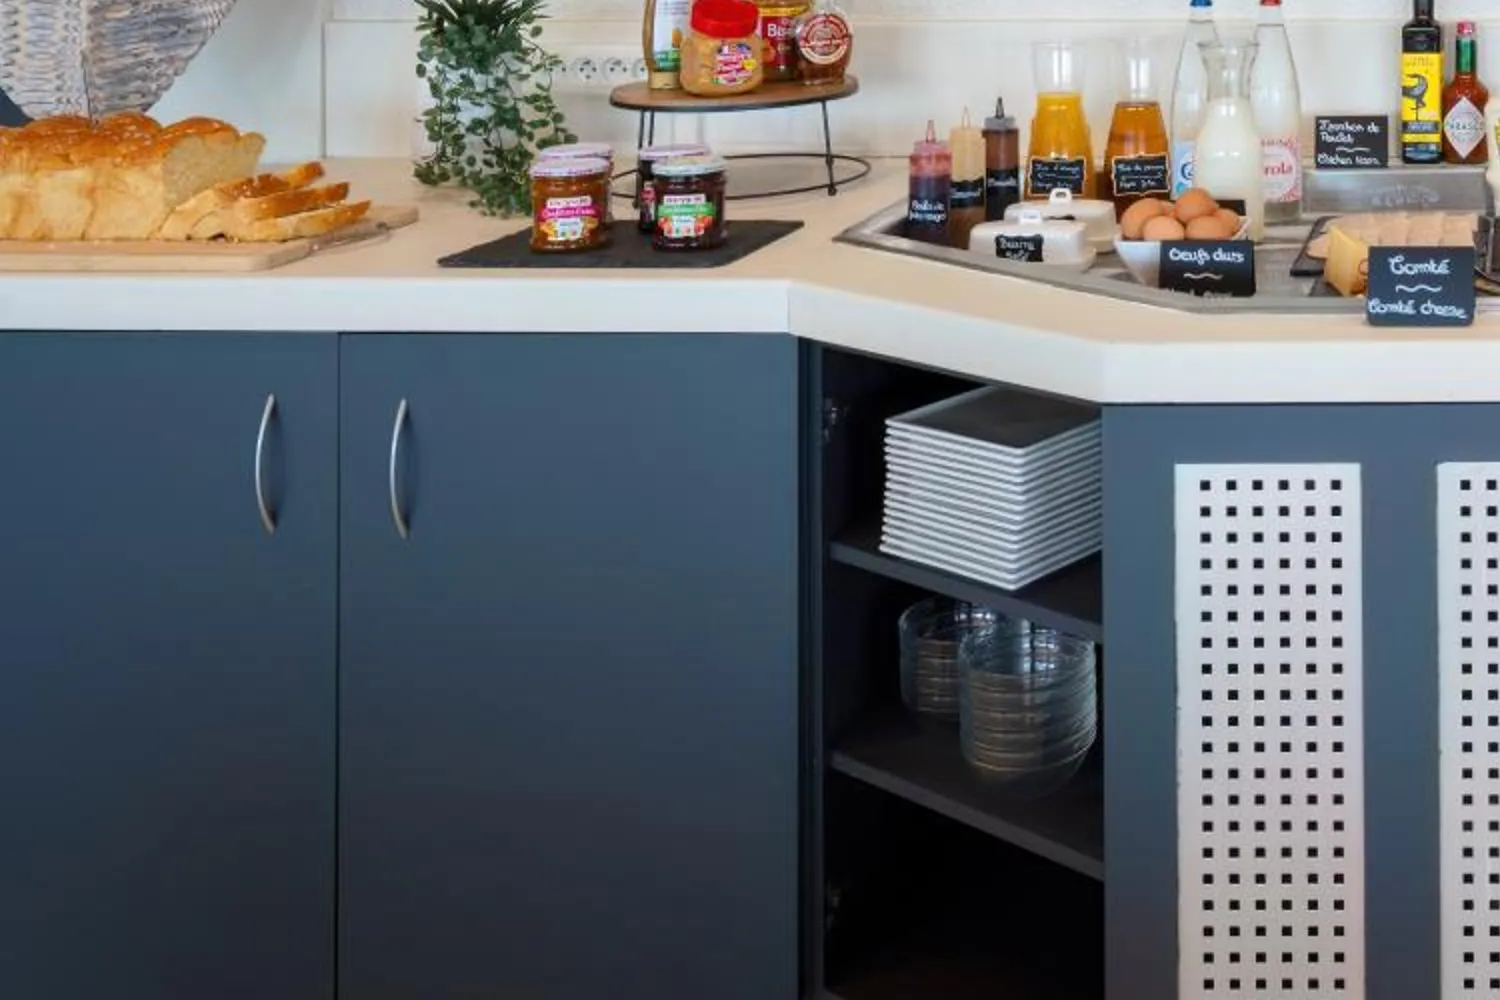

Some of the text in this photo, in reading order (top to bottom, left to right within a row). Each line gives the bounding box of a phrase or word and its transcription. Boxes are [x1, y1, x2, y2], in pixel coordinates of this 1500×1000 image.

[1387, 254, 1452, 276] Comté
[1367, 297, 1469, 320] Comté cheese
